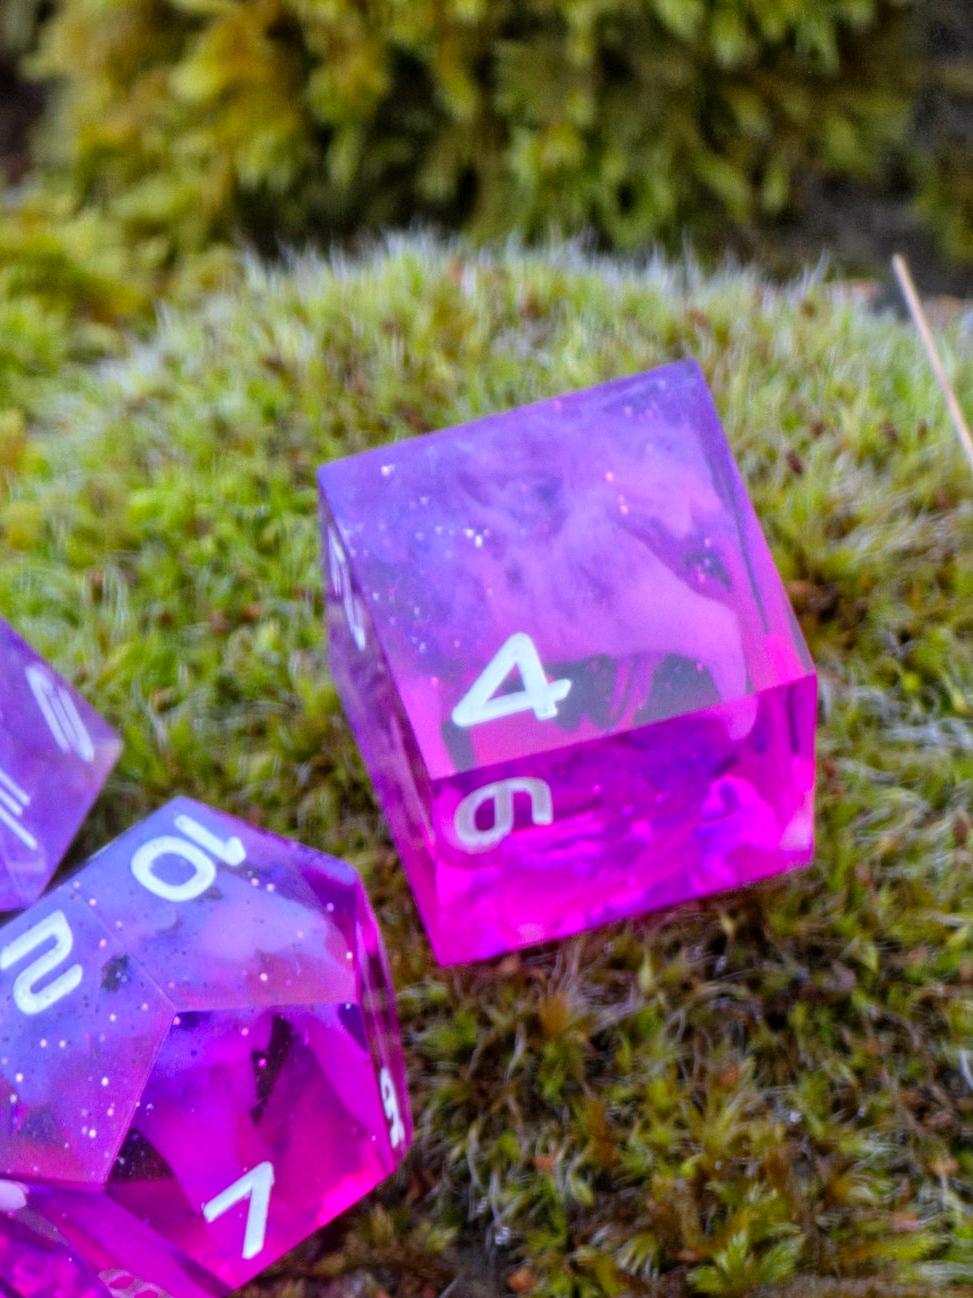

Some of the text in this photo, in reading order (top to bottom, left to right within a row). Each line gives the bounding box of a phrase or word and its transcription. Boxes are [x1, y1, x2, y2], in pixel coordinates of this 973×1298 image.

[452, 632, 573, 728] 4
[130, 811, 247, 903] 10
[203, 1163, 273, 1259] 7
